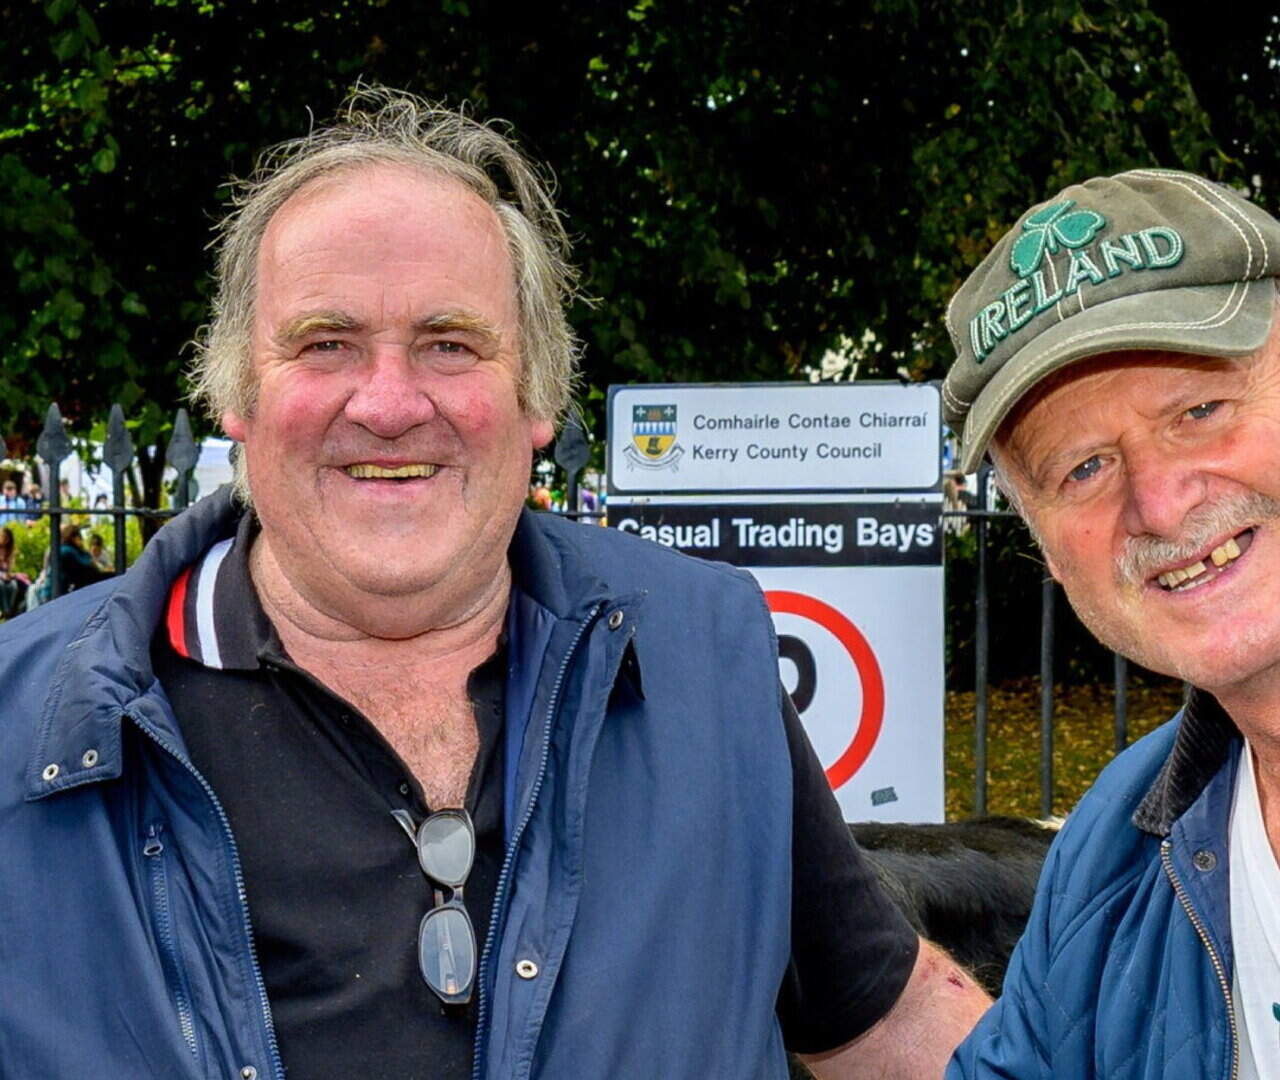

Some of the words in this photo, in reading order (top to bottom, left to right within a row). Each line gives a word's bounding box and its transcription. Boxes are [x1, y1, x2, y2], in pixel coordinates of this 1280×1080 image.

[968, 226, 1185, 364] IRELAND
[693, 414, 780, 430] Comhairle
[788, 413, 851, 429] Contae
[859, 412, 927, 428] Chiarraí
[692, 445, 738, 462] Kerry
[746, 444, 808, 461] County
[816, 443, 882, 459] Council
[732, 518, 844, 554] Trading
[856, 517, 934, 552] Bays
